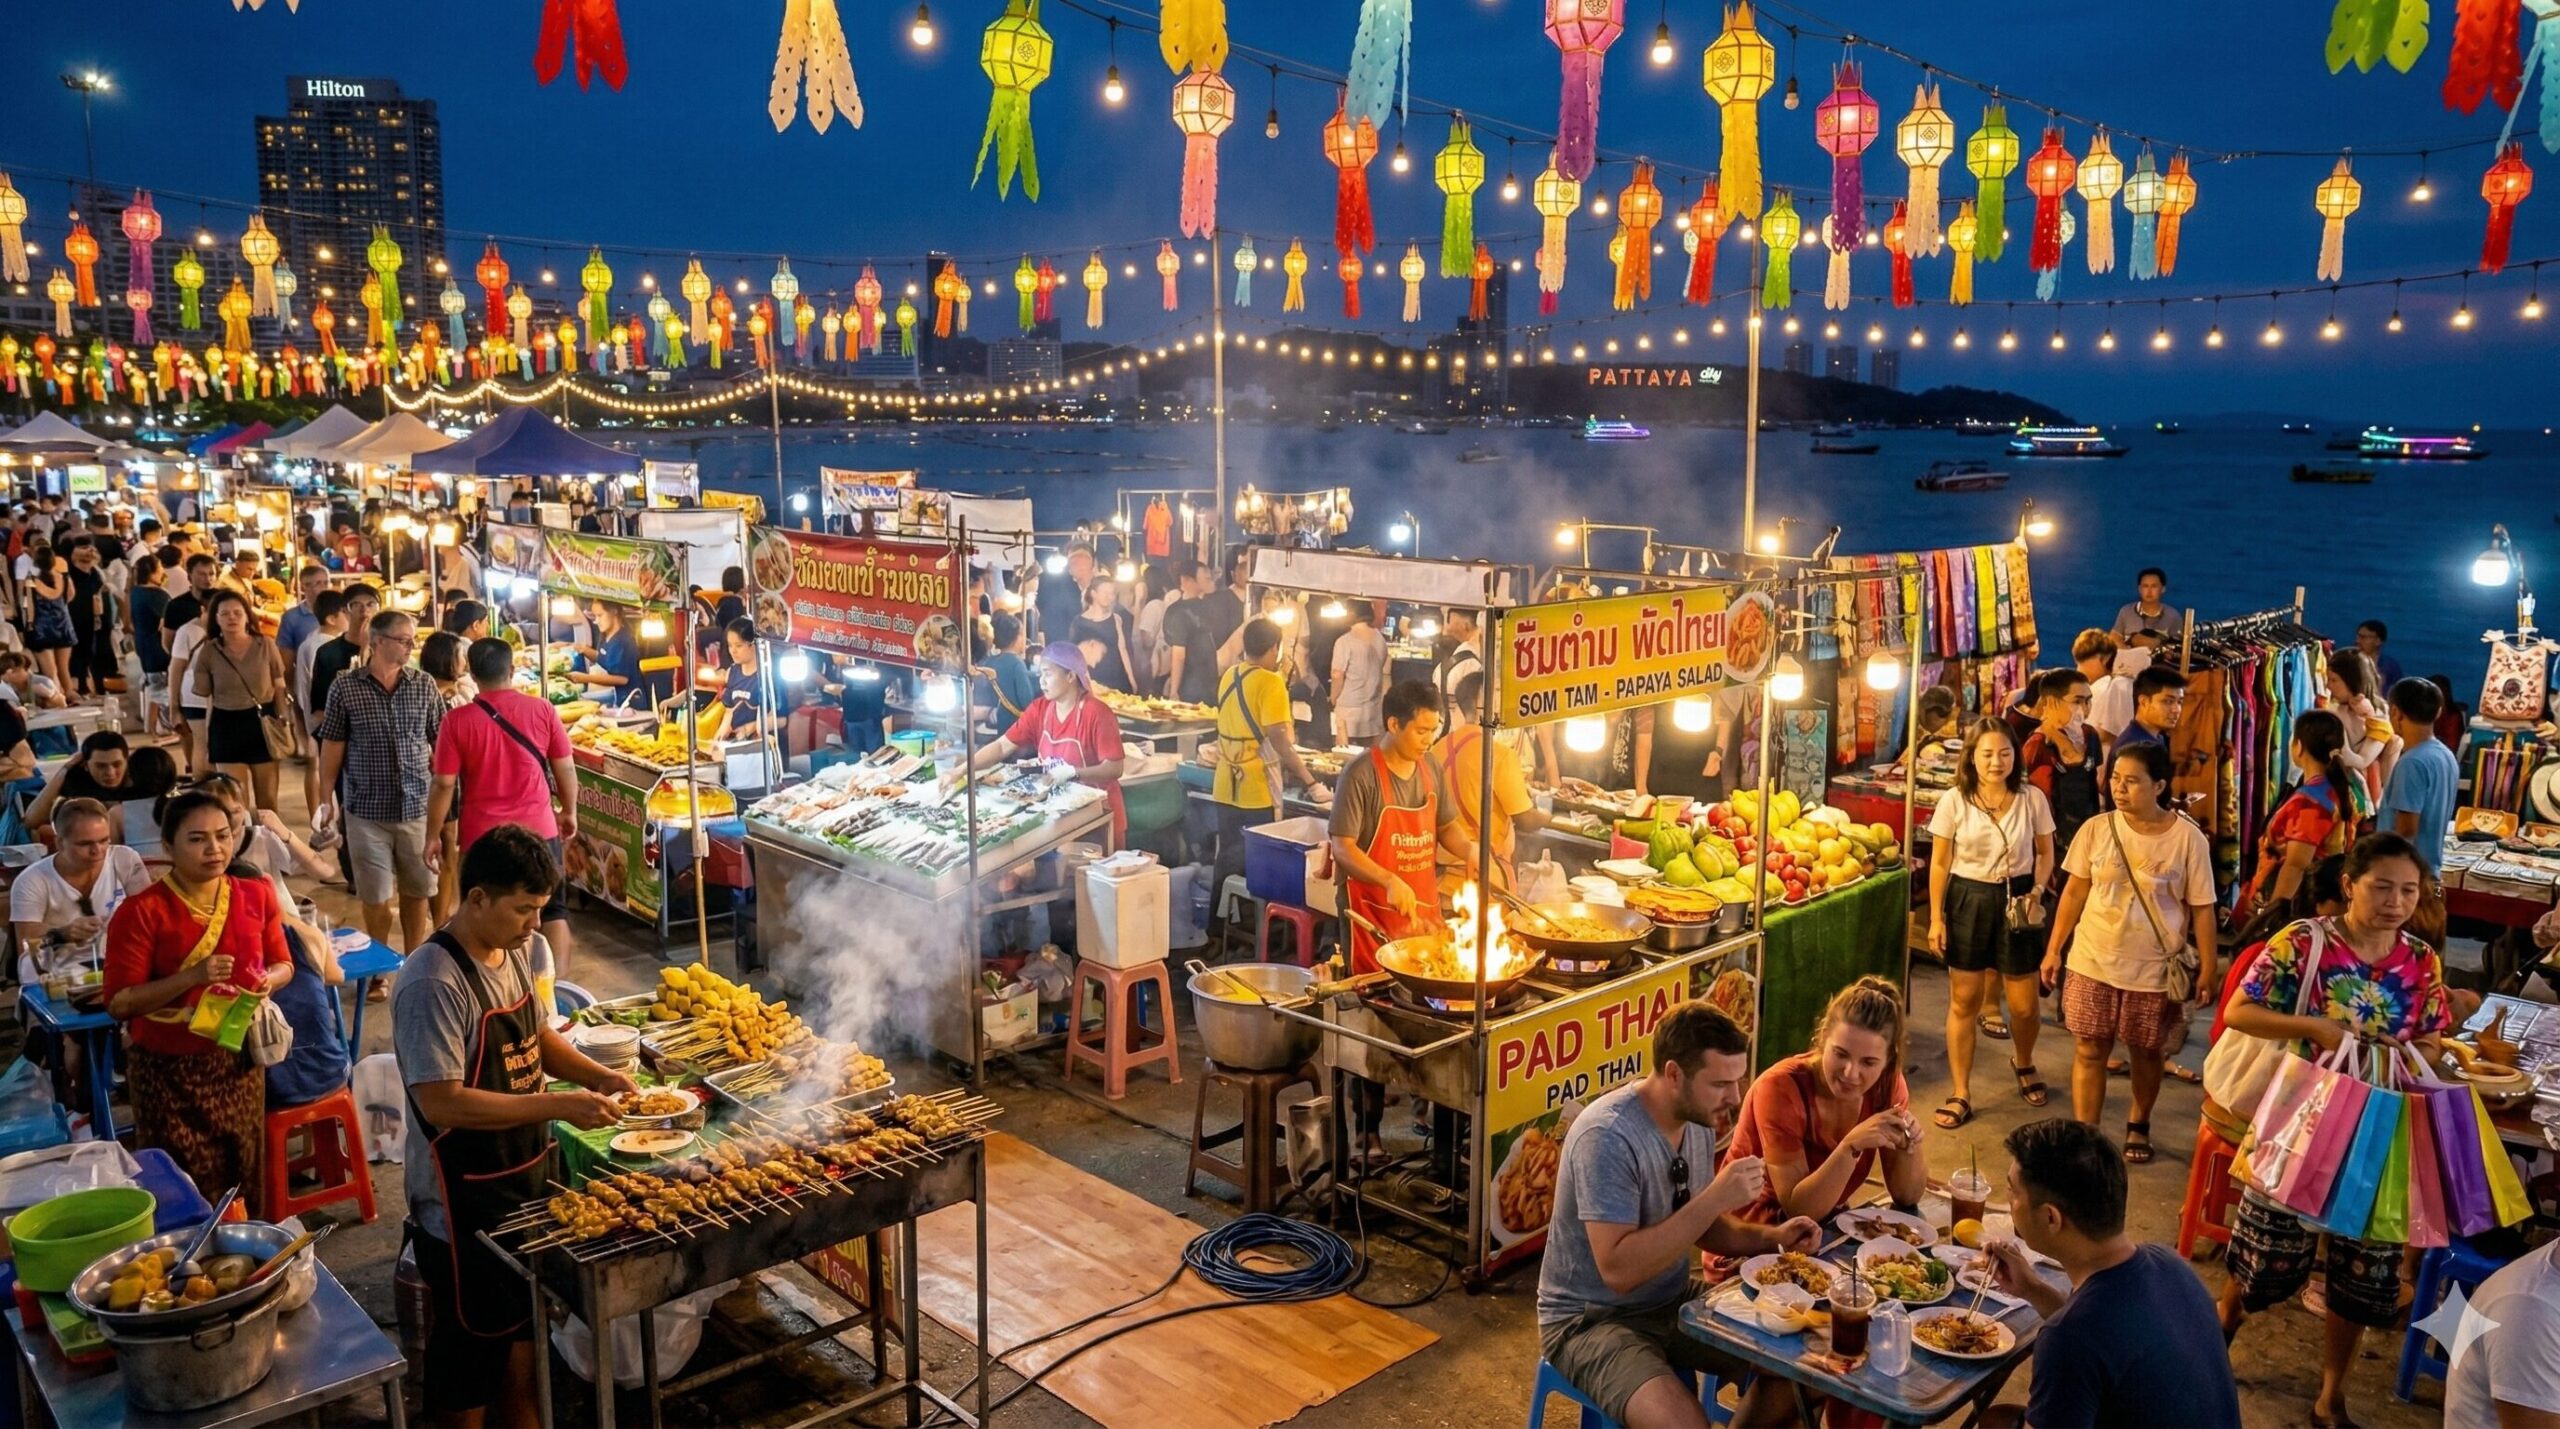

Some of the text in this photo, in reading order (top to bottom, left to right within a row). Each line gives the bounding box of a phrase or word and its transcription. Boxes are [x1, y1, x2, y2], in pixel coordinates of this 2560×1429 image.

[306, 79, 366, 98] Hilton
[1588, 367, 1692, 386] PATTAYA
[1518, 689, 1557, 718] SOM
[1565, 683, 1598, 708] TAM
[1616, 671, 1672, 700] PAPAYA
[1677, 662, 1723, 688] SALAD
[1498, 1020, 1584, 1090] PAD
[1546, 1051, 1642, 1110] PAD THAI
